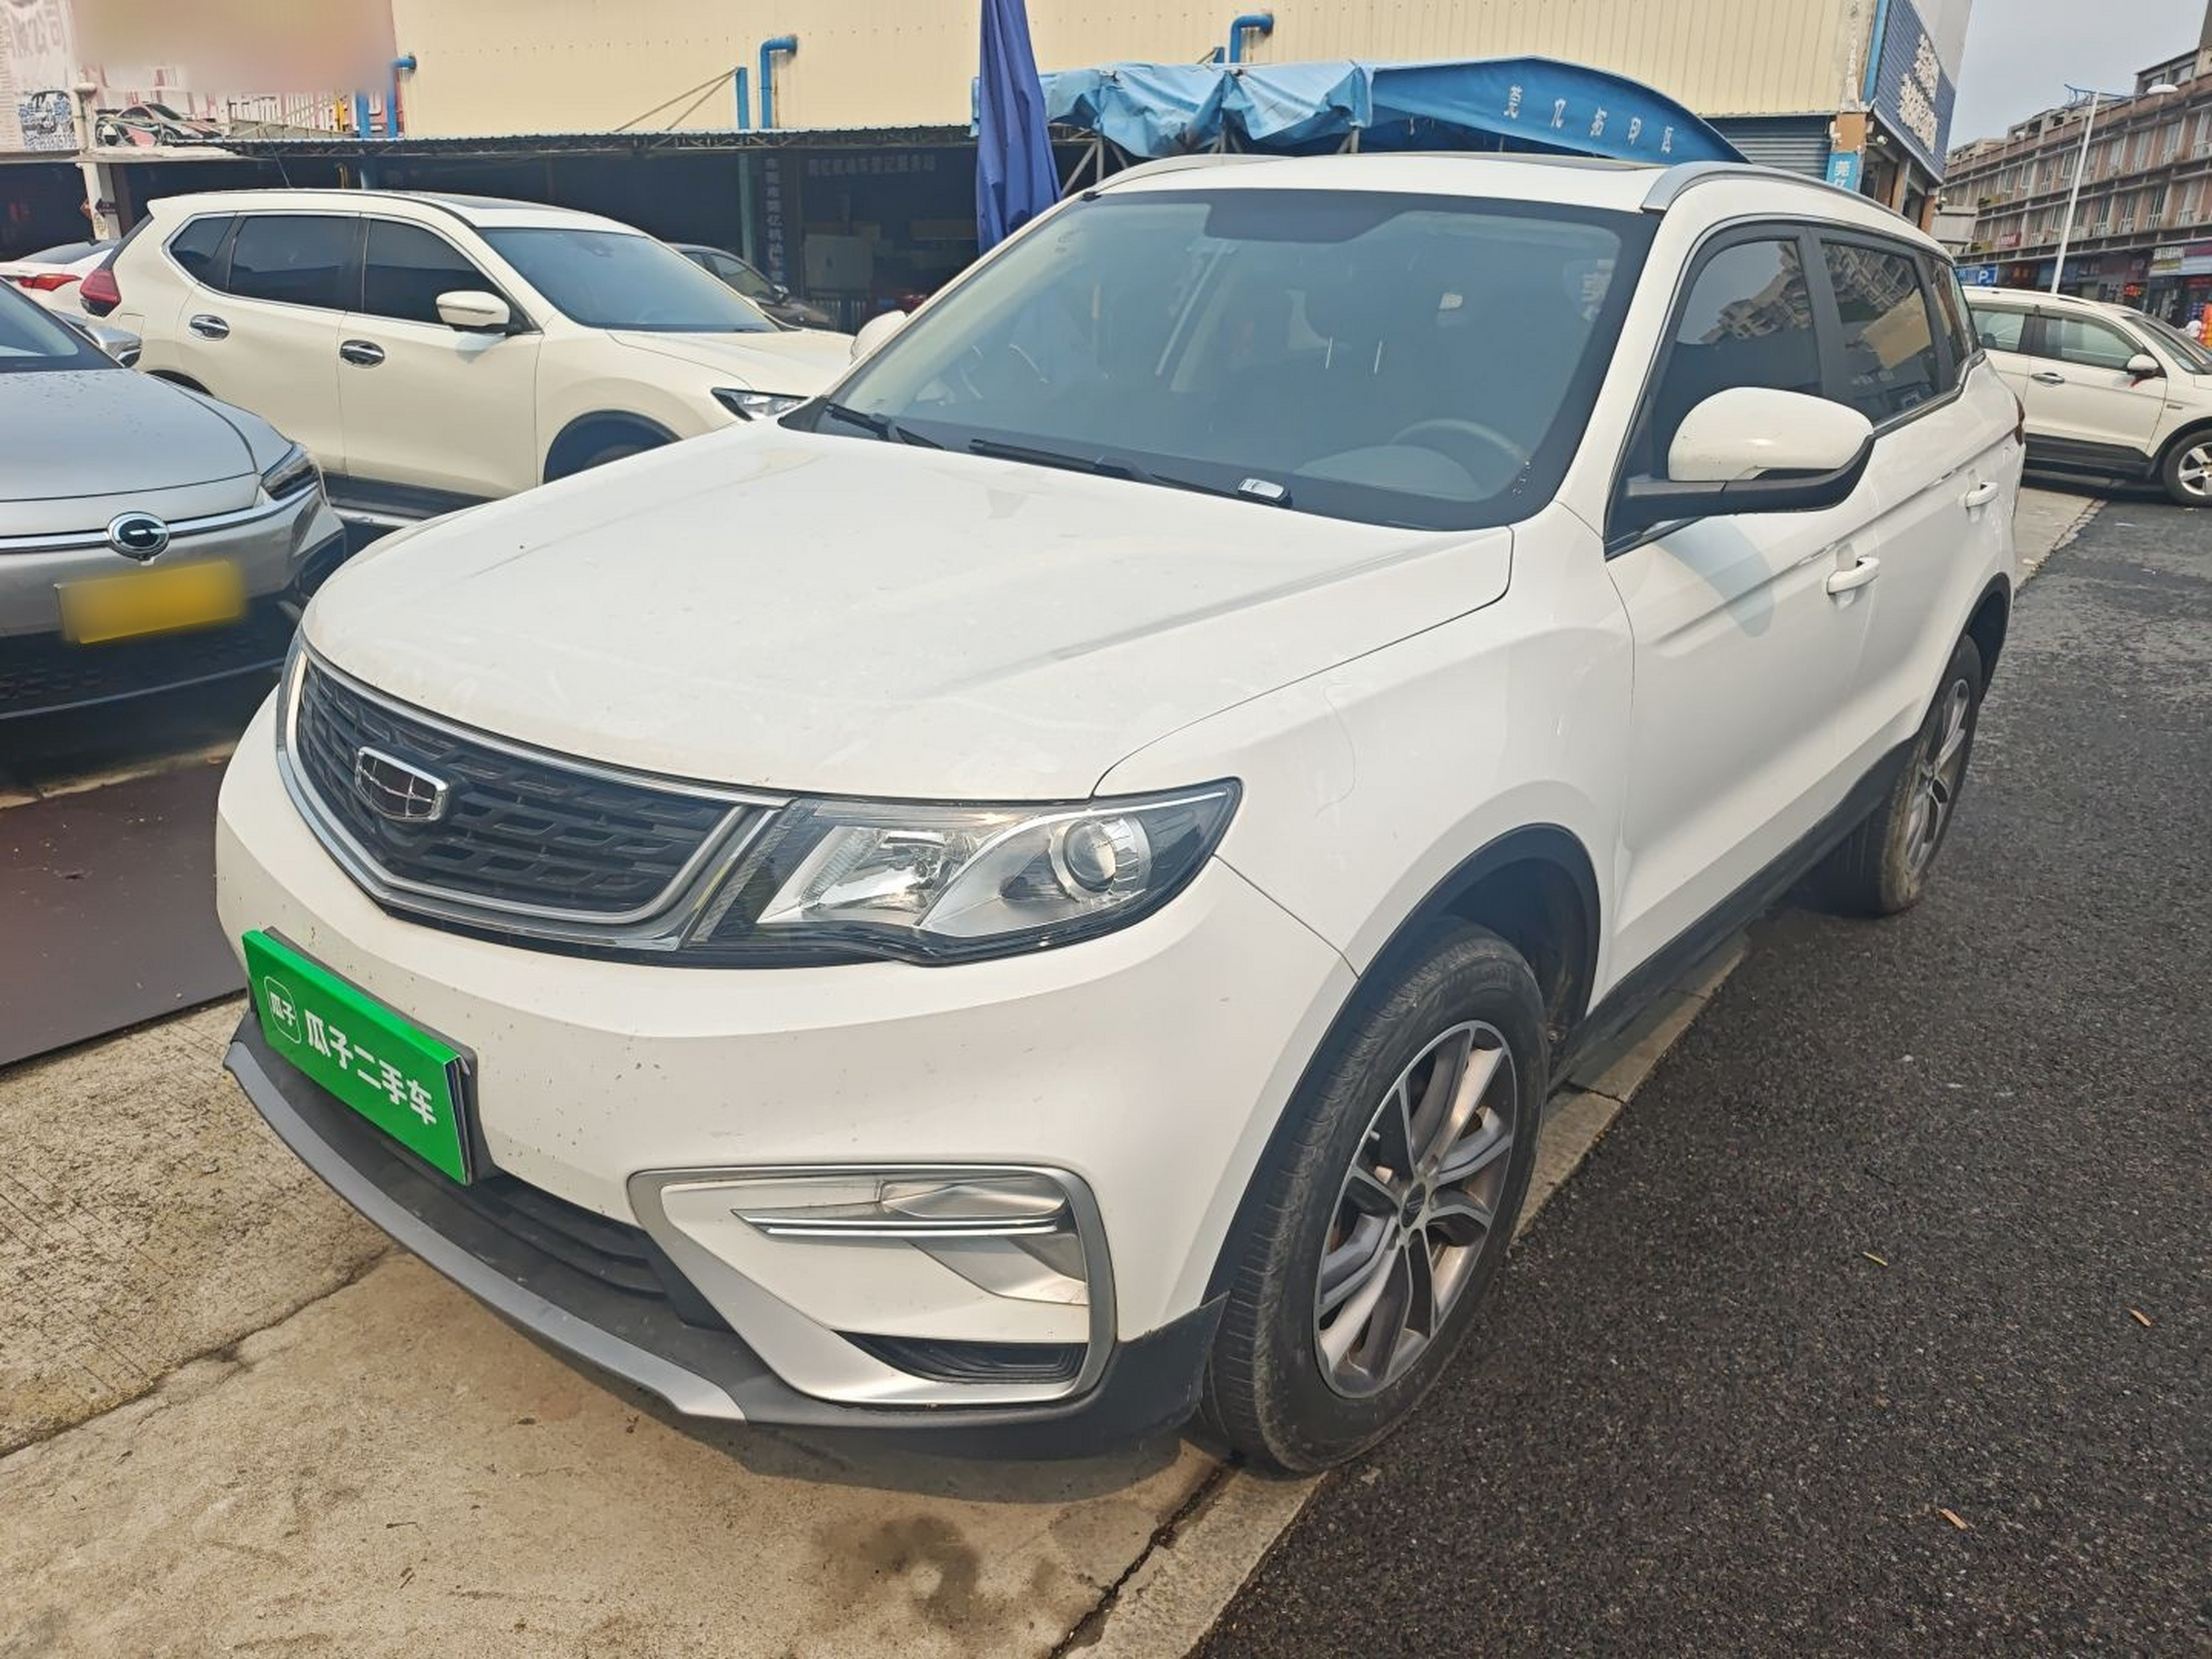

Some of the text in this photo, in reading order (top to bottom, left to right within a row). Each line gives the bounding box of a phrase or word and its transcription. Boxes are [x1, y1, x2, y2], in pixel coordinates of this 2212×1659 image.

[1978, 270, 1989, 284] P
[270, 991, 296, 1027] 瓜子
[305, 1009, 437, 1125] 瓜子二手车
